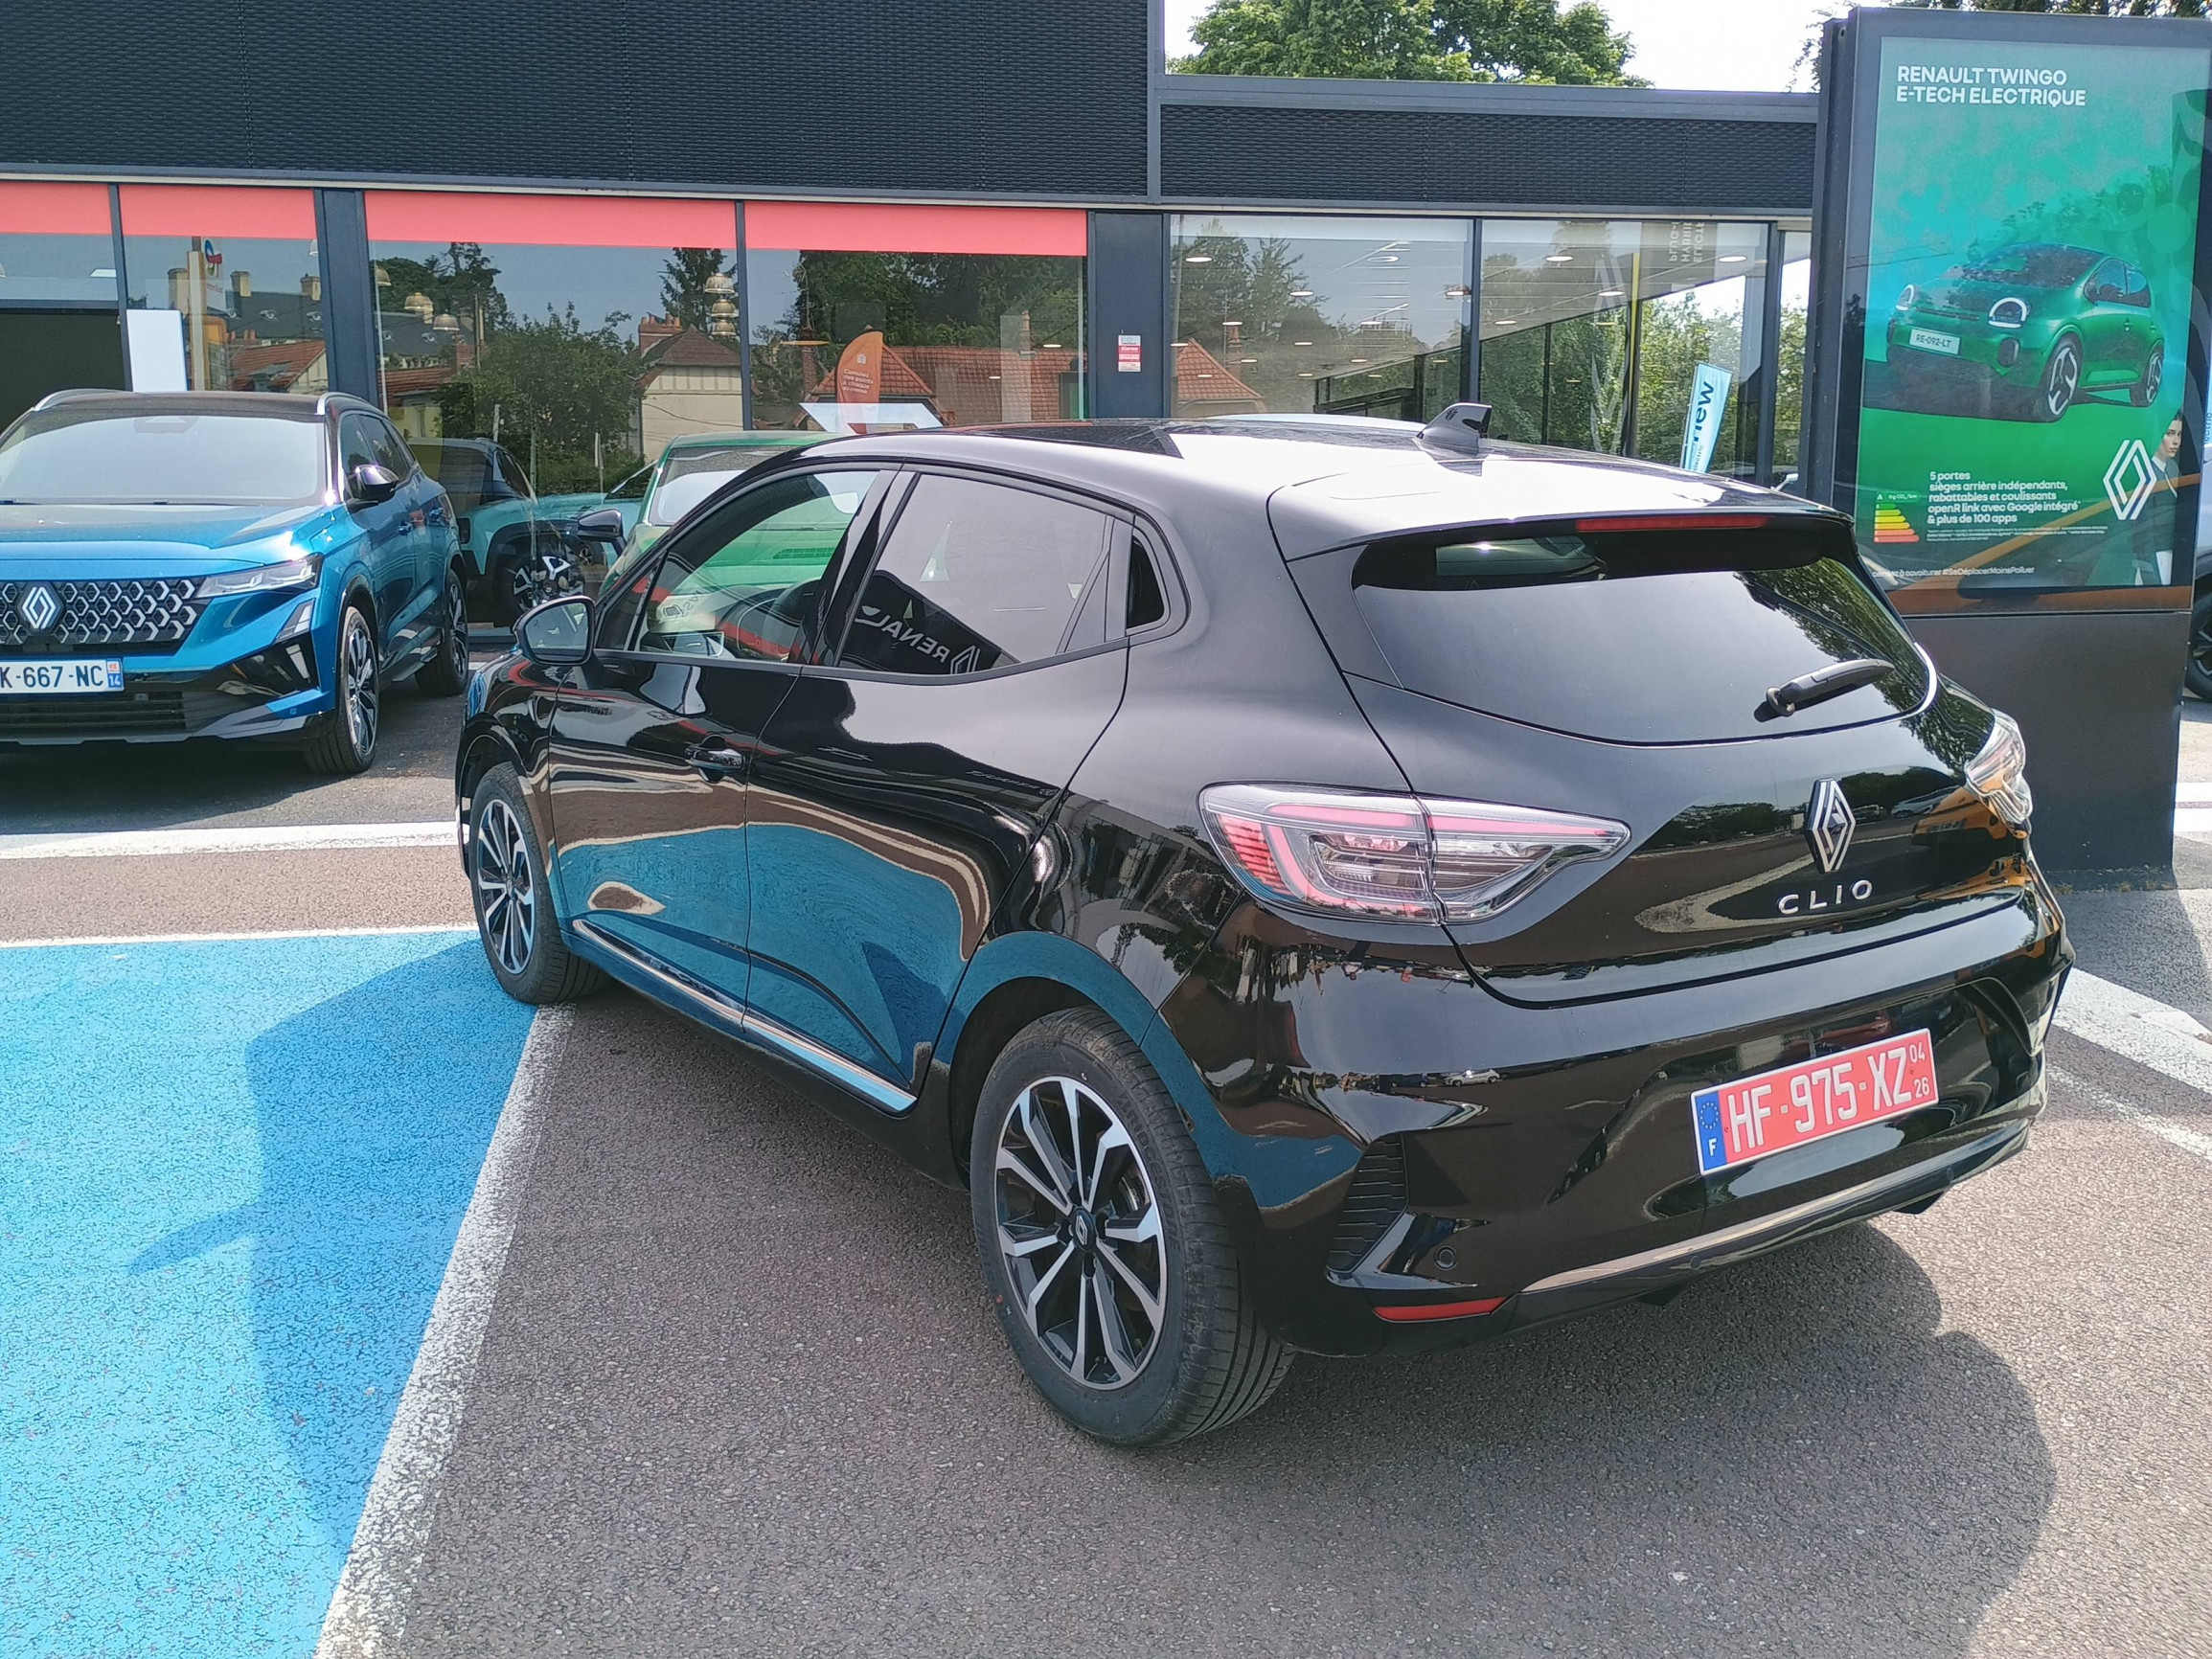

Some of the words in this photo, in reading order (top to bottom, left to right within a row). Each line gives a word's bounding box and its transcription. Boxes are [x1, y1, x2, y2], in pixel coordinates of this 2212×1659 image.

[1897, 65, 1984, 84] RENAULT
[1987, 67, 2067, 86] TWINGO
[1896, 85, 1965, 103] E-TECH
[1969, 87, 2087, 107] ELECTRIQUE
[1694, 381, 1714, 442] new
[1929, 482, 1962, 493] sièges
[1963, 481, 1997, 490] arrière
[1997, 480, 2068, 491] indépendants,
[1930, 471, 1936, 480] 5
[1937, 472, 1971, 483] portes
[1928, 492, 1989, 502] rabattables
[1990, 492, 2000, 502] et
[2001, 491, 2057, 501] coulissants
[1927, 504, 1961, 515] openR
[1962, 503, 1980, 512] link
[1981, 504, 2006, 512] avec
[2007, 502, 2042, 513] Google
[1927, 515, 1935, 524] &
[1936, 514, 1958, 526] plus
[1959, 513, 1973, 524] de
[1973, 513, 1991, 523] 100
[1992, 514, 2018, 525] apps
[1778, 879, 1873, 914] CLIO
[1908, 1042, 1926, 1064] 04
[1913, 1078, 1929, 1099] 26
[1708, 1138, 1718, 1157] F
